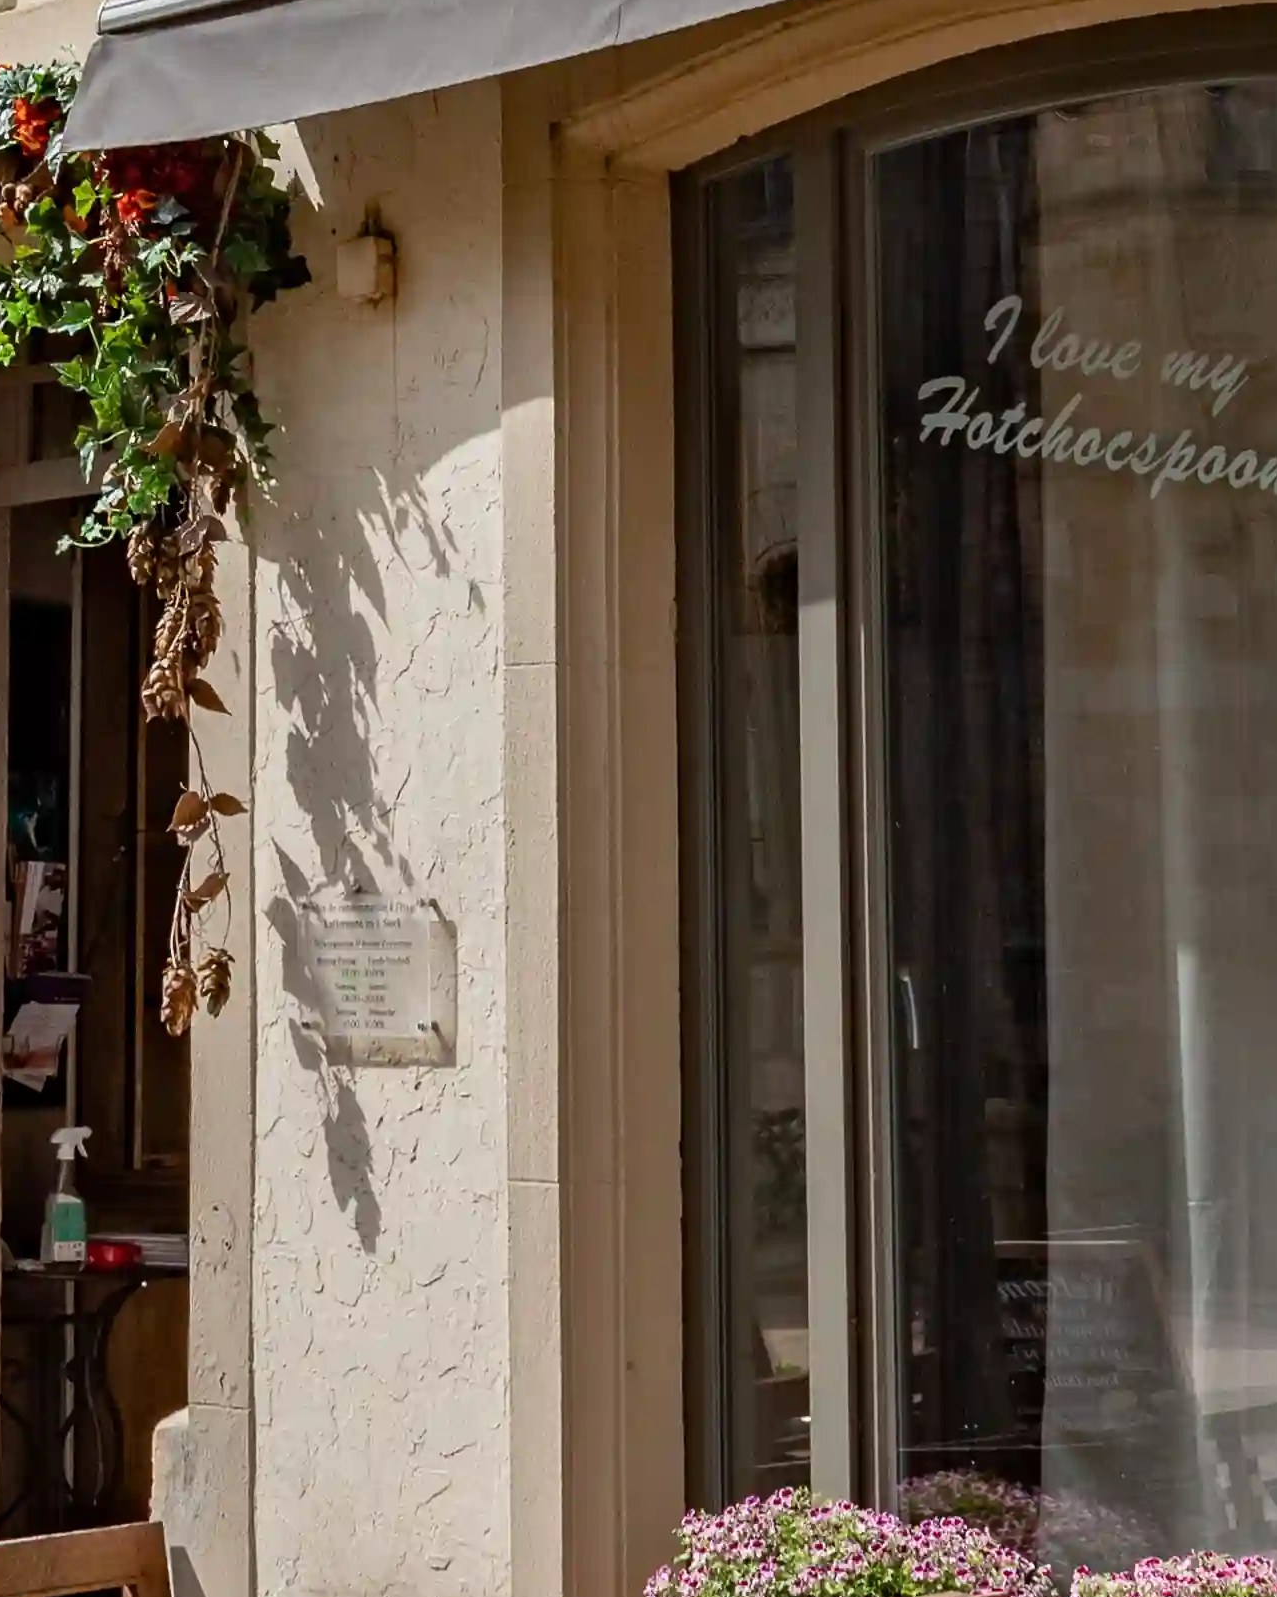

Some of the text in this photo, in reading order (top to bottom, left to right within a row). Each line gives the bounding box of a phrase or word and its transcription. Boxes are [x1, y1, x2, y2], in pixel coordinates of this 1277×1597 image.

[983, 294, 1251, 417] I love my
